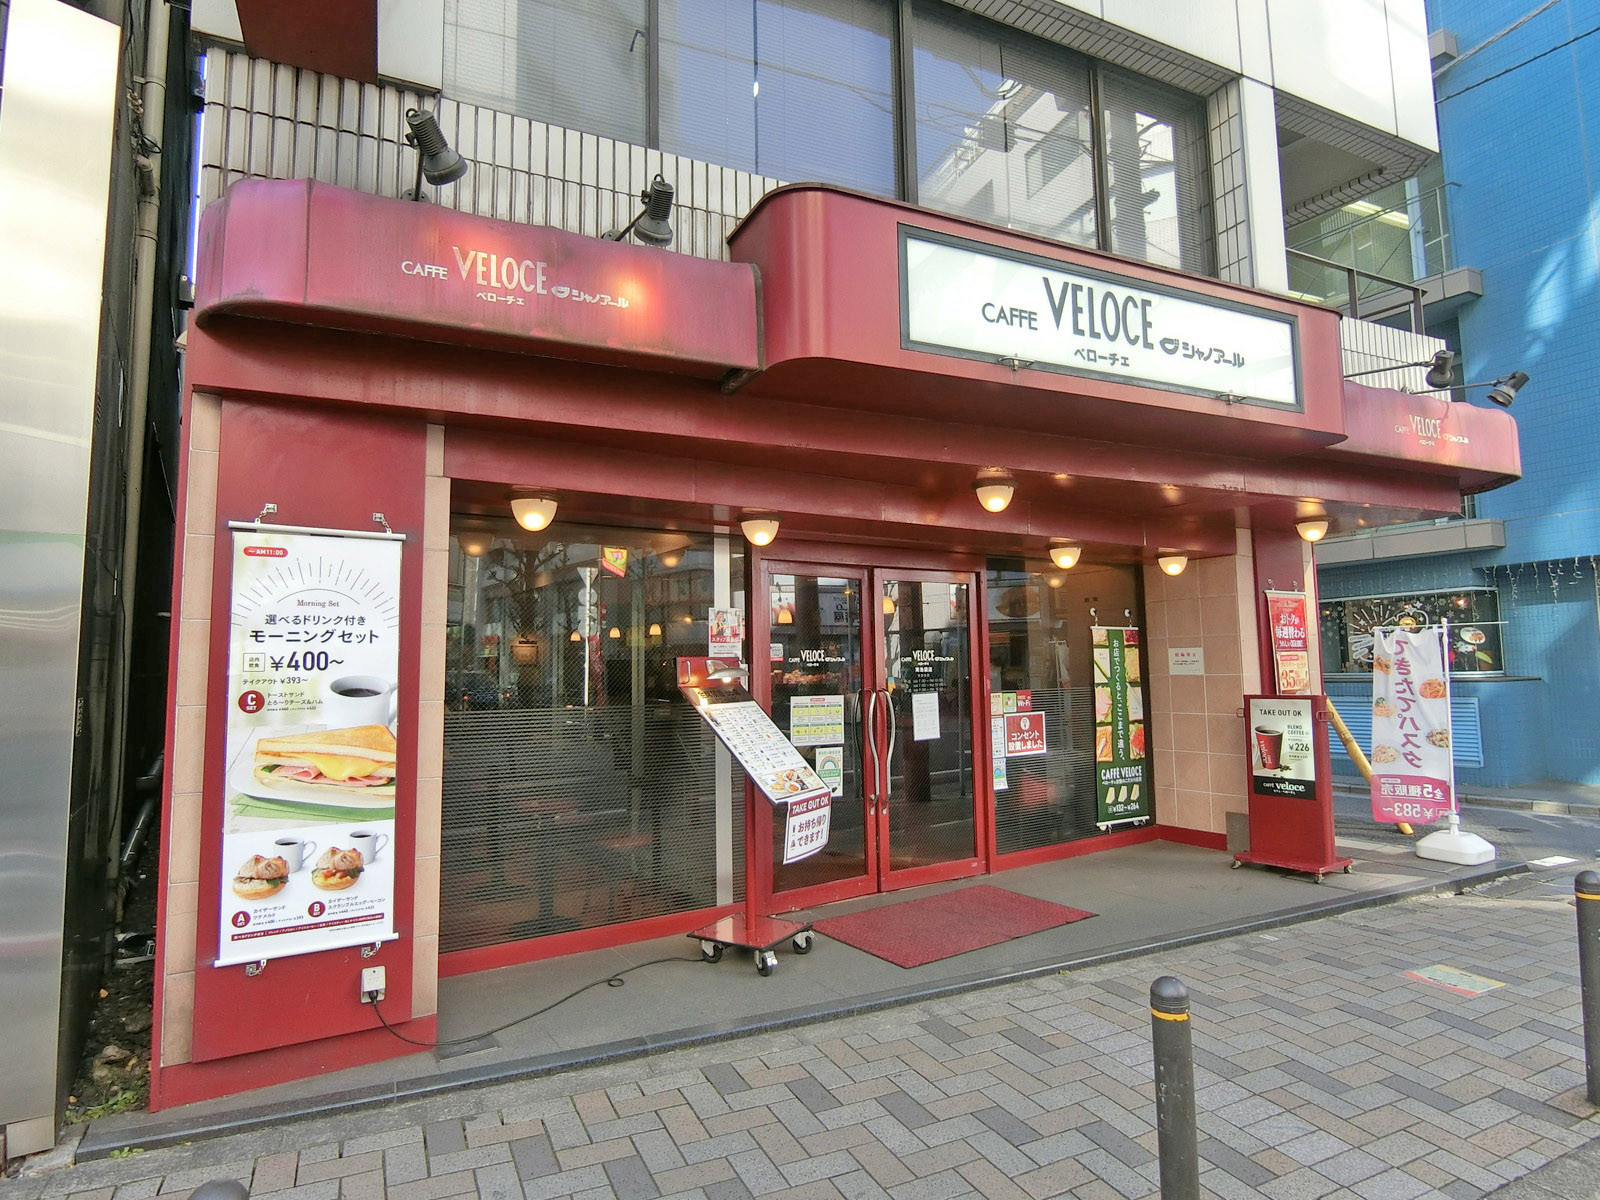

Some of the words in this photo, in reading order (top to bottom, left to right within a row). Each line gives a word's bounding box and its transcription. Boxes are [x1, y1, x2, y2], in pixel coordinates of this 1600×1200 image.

[400, 260, 448, 280] CAFFE
[452, 246, 548, 295] VELOCE
[476, 292, 525, 306] ベローチェ
[571, 288, 630, 309] シャノアール
[981, 302, 1039, 331] CAFFE
[1042, 276, 1154, 350] VELOCE
[1074, 347, 1130, 367] ベローチェ
[1182, 341, 1245, 368] シャノアール
[1408, 414, 1442, 439] VELOCE
[297, 599, 326, 609] Morning
[264, 614, 367, 626] 選べるドリンク付き
[249, 629, 380, 644] モーニングセット
[800, 649, 825, 662] VELOCE
[912, 650, 935, 661] VELOCE
[247, 693, 257, 705] C
[1259, 708, 1276, 716] TAKE
[1011, 730, 1040, 741] コンセント
[1008, 739, 1043, 751] 設置しました
[1289, 742, 1310, 752] ¥226
[1120, 765, 1142, 778] VELOCE
[1275, 781, 1306, 792] veloce
[792, 802, 808, 814] TAKE
[807, 798, 820, 810] OUT
[820, 795, 829, 806] OK
[797, 814, 827, 832] お持ち帰り
[313, 903, 321, 912] B
[237, 914, 245, 922] A
